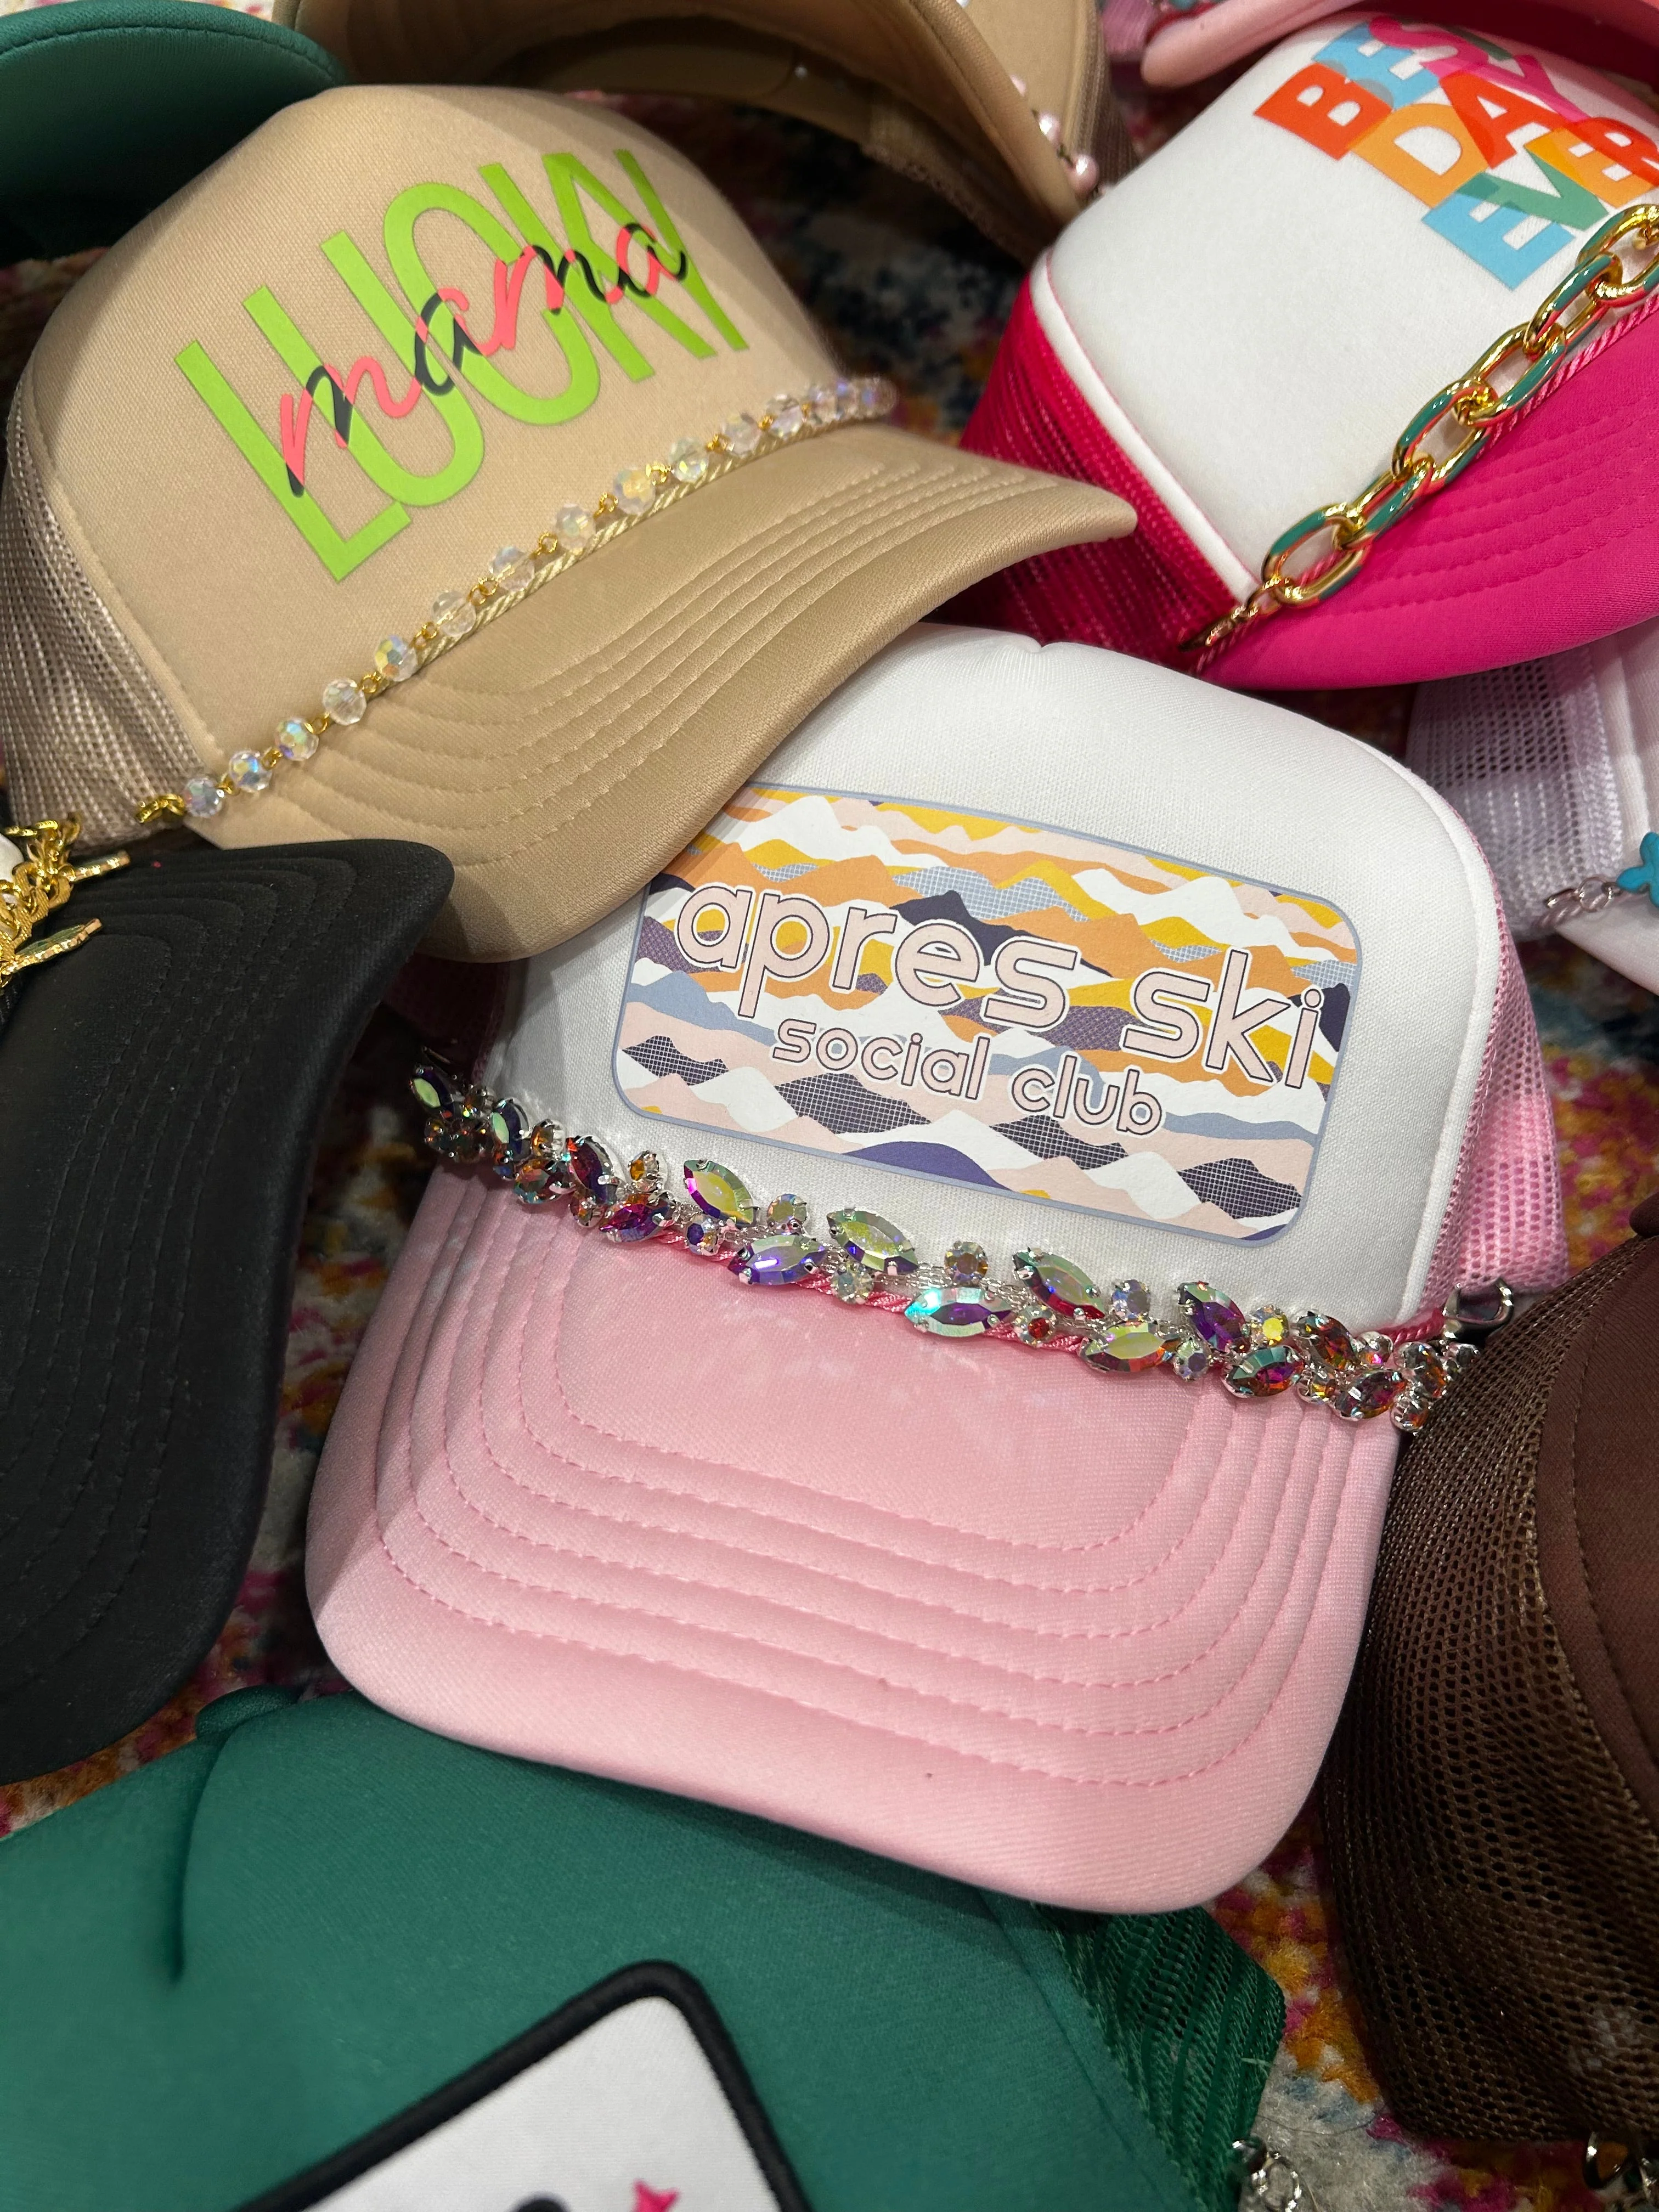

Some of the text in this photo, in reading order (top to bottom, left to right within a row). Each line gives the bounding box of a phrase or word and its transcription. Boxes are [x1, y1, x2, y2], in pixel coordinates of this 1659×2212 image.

[1254, 15, 1513, 161] BES
[1346, 55, 1594, 209] DAY
[174, 149, 749, 583] LUCKY
[280, 222, 687, 498] mama
[676, 885, 1323, 1089] apres ski
[772, 1018, 1163, 1135] social club
